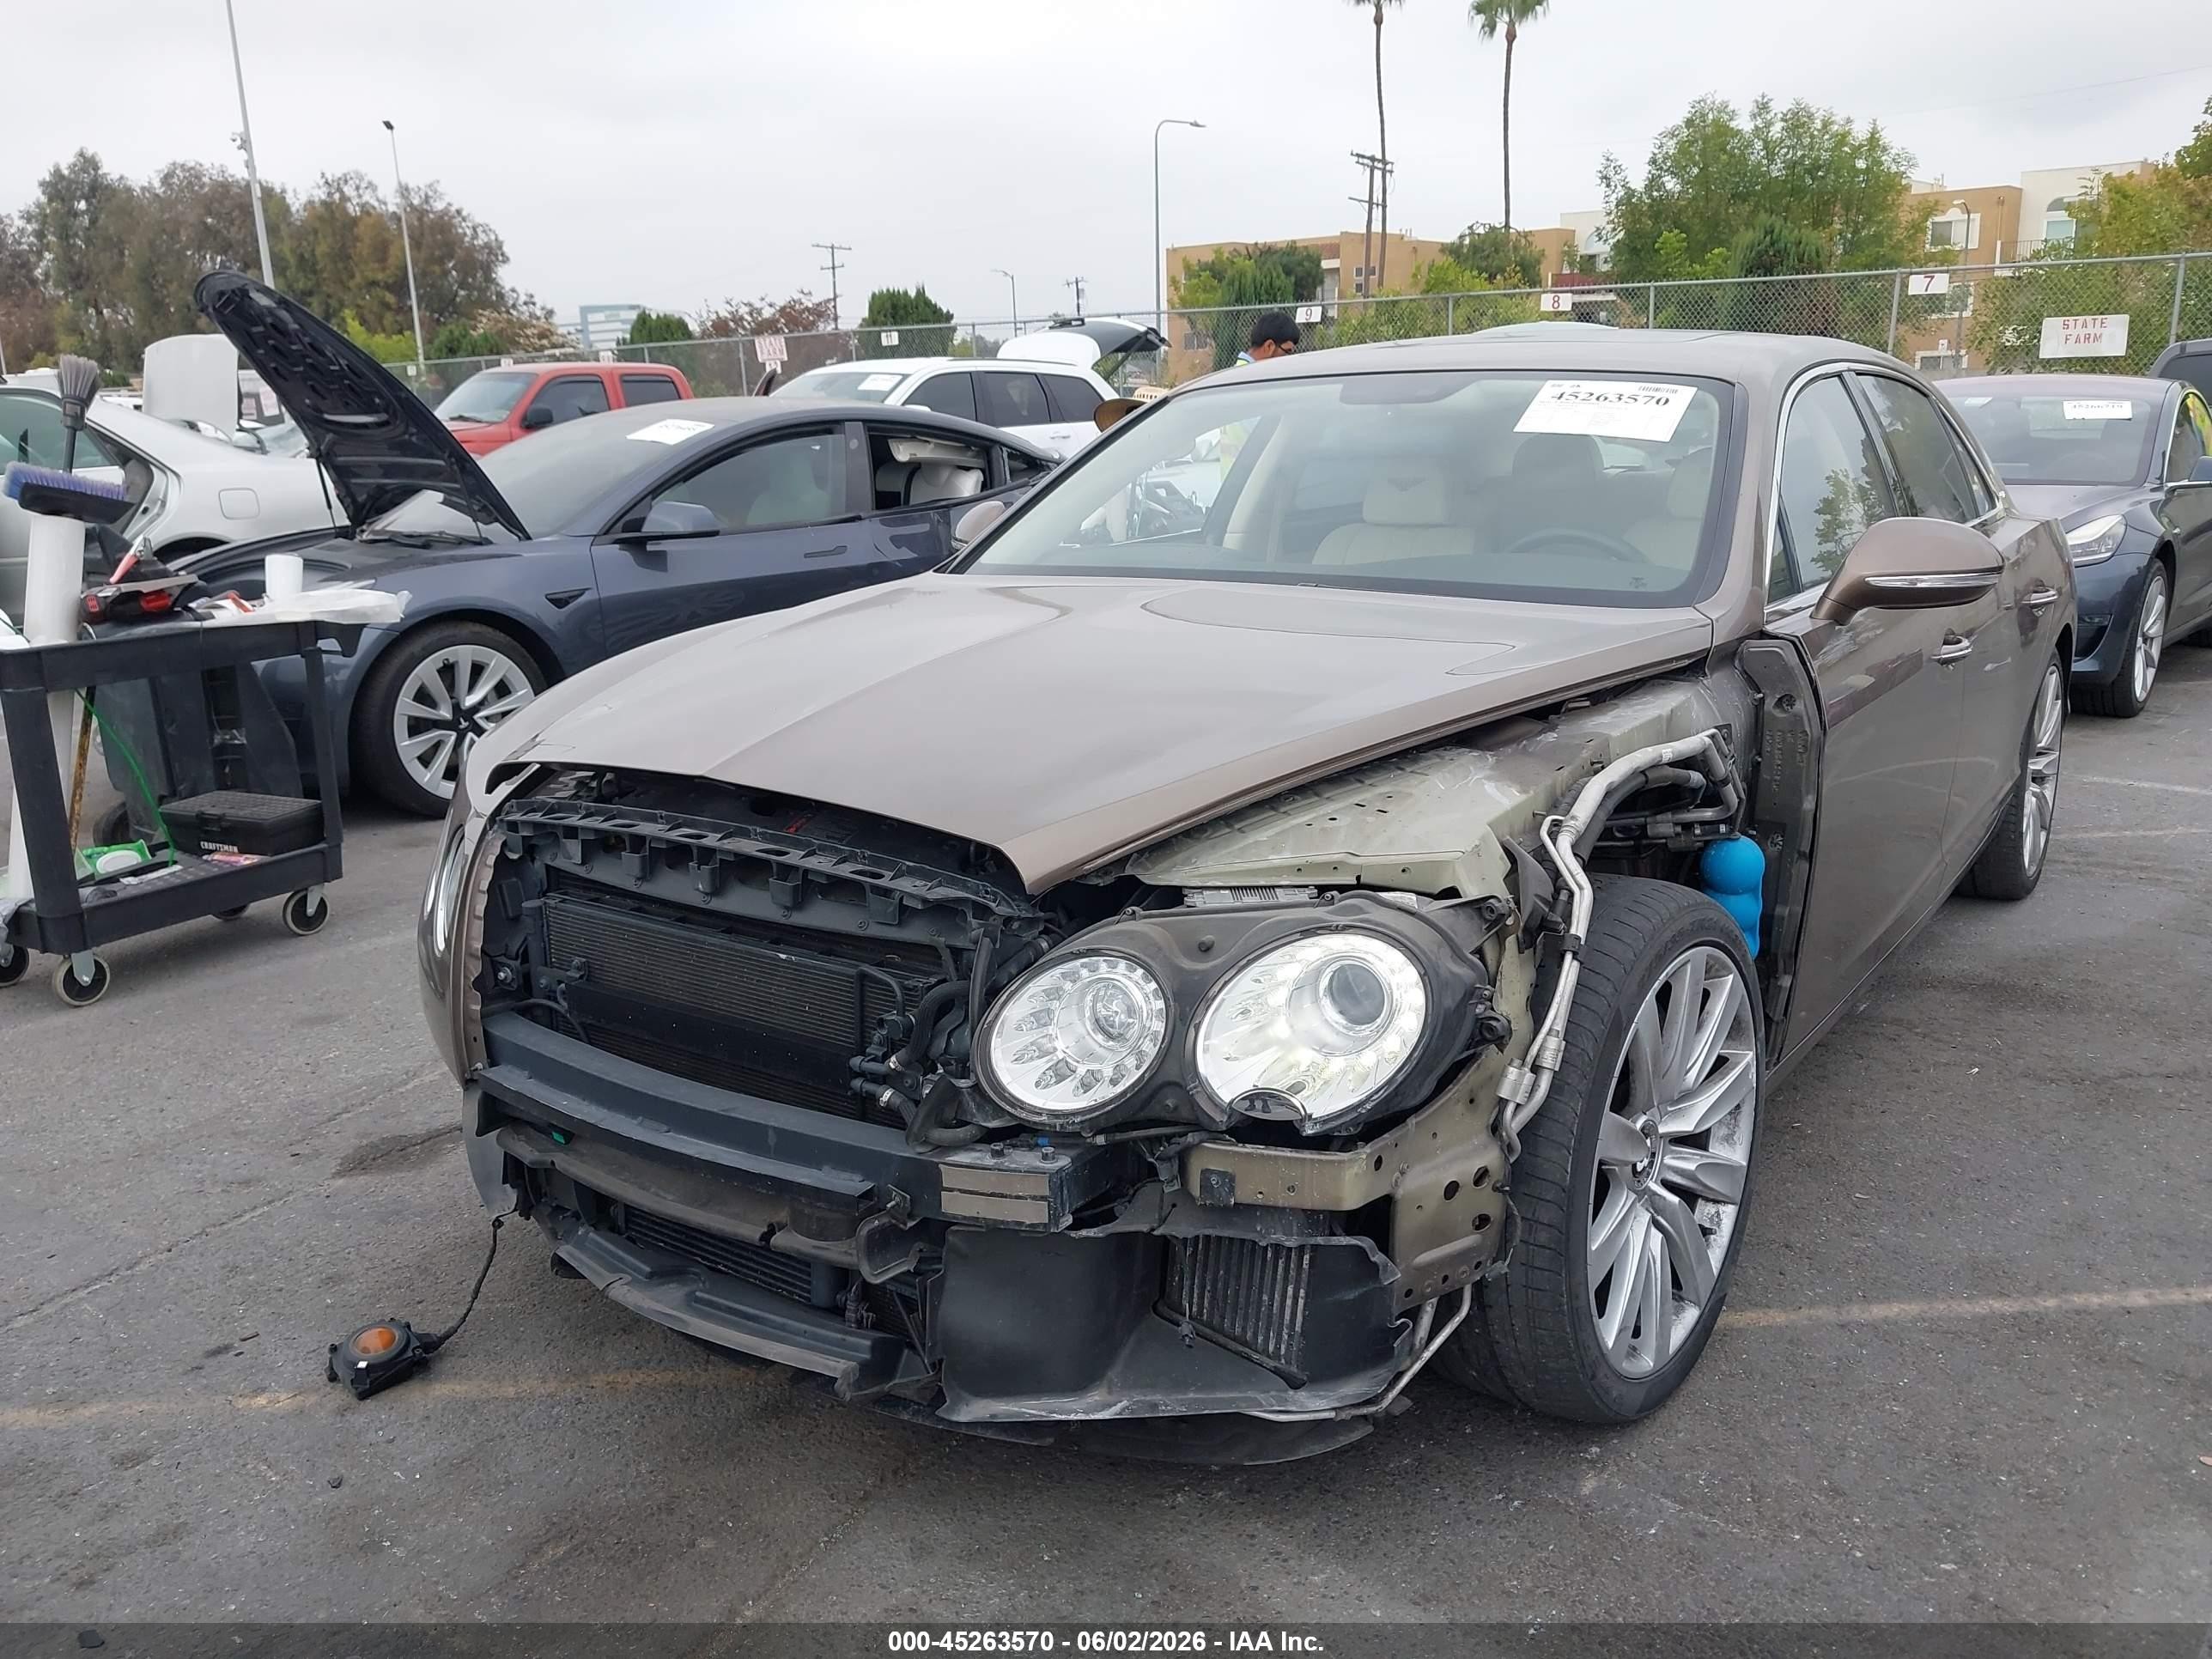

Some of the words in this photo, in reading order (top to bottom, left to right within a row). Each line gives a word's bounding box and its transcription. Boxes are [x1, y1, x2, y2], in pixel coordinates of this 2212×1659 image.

[1923, 275, 1936, 293] 7
[1552, 295, 1560, 310] 8
[1305, 307, 1313, 321] 9
[2062, 317, 2108, 331] STATE
[2064, 332, 2103, 344] FARM
[1551, 391, 1670, 407] 45263570
[199, 841, 240, 853] CRAFTSMAN
